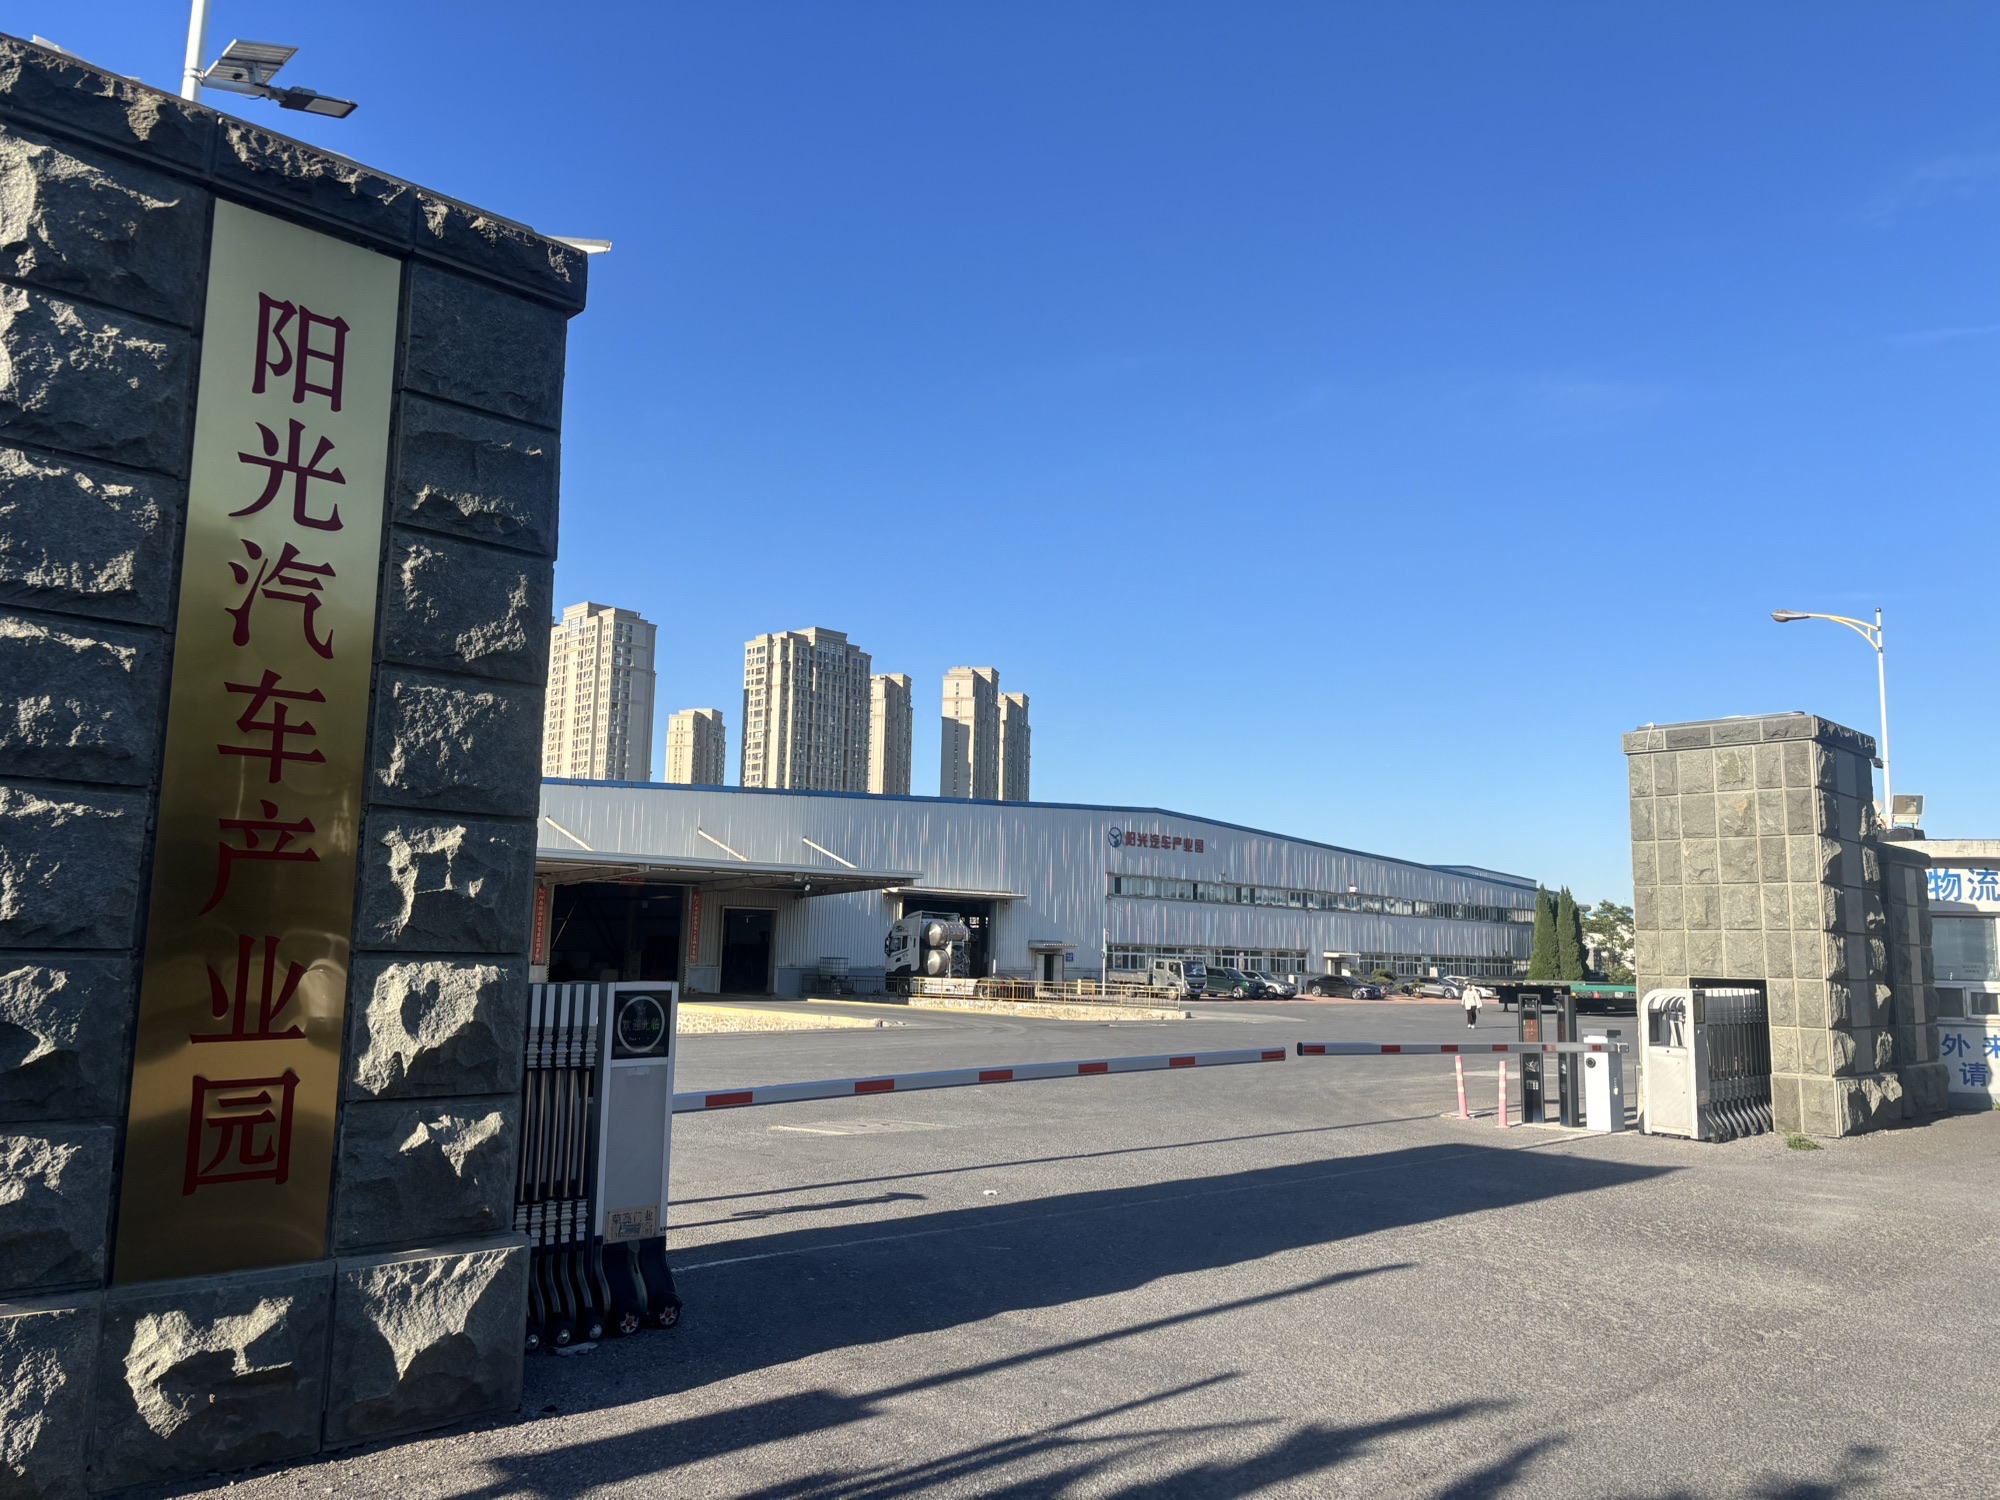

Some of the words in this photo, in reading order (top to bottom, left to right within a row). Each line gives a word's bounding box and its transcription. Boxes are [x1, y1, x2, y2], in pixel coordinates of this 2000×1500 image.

[183, 292, 350, 1196] 阳光汽车产业园
[1124, 831, 1204, 853] 阳光汽车产业园
[1928, 867, 2000, 901] 物流
[621, 1016, 661, 1032] 欢迎光临
[1959, 1062, 1988, 1087] 请
